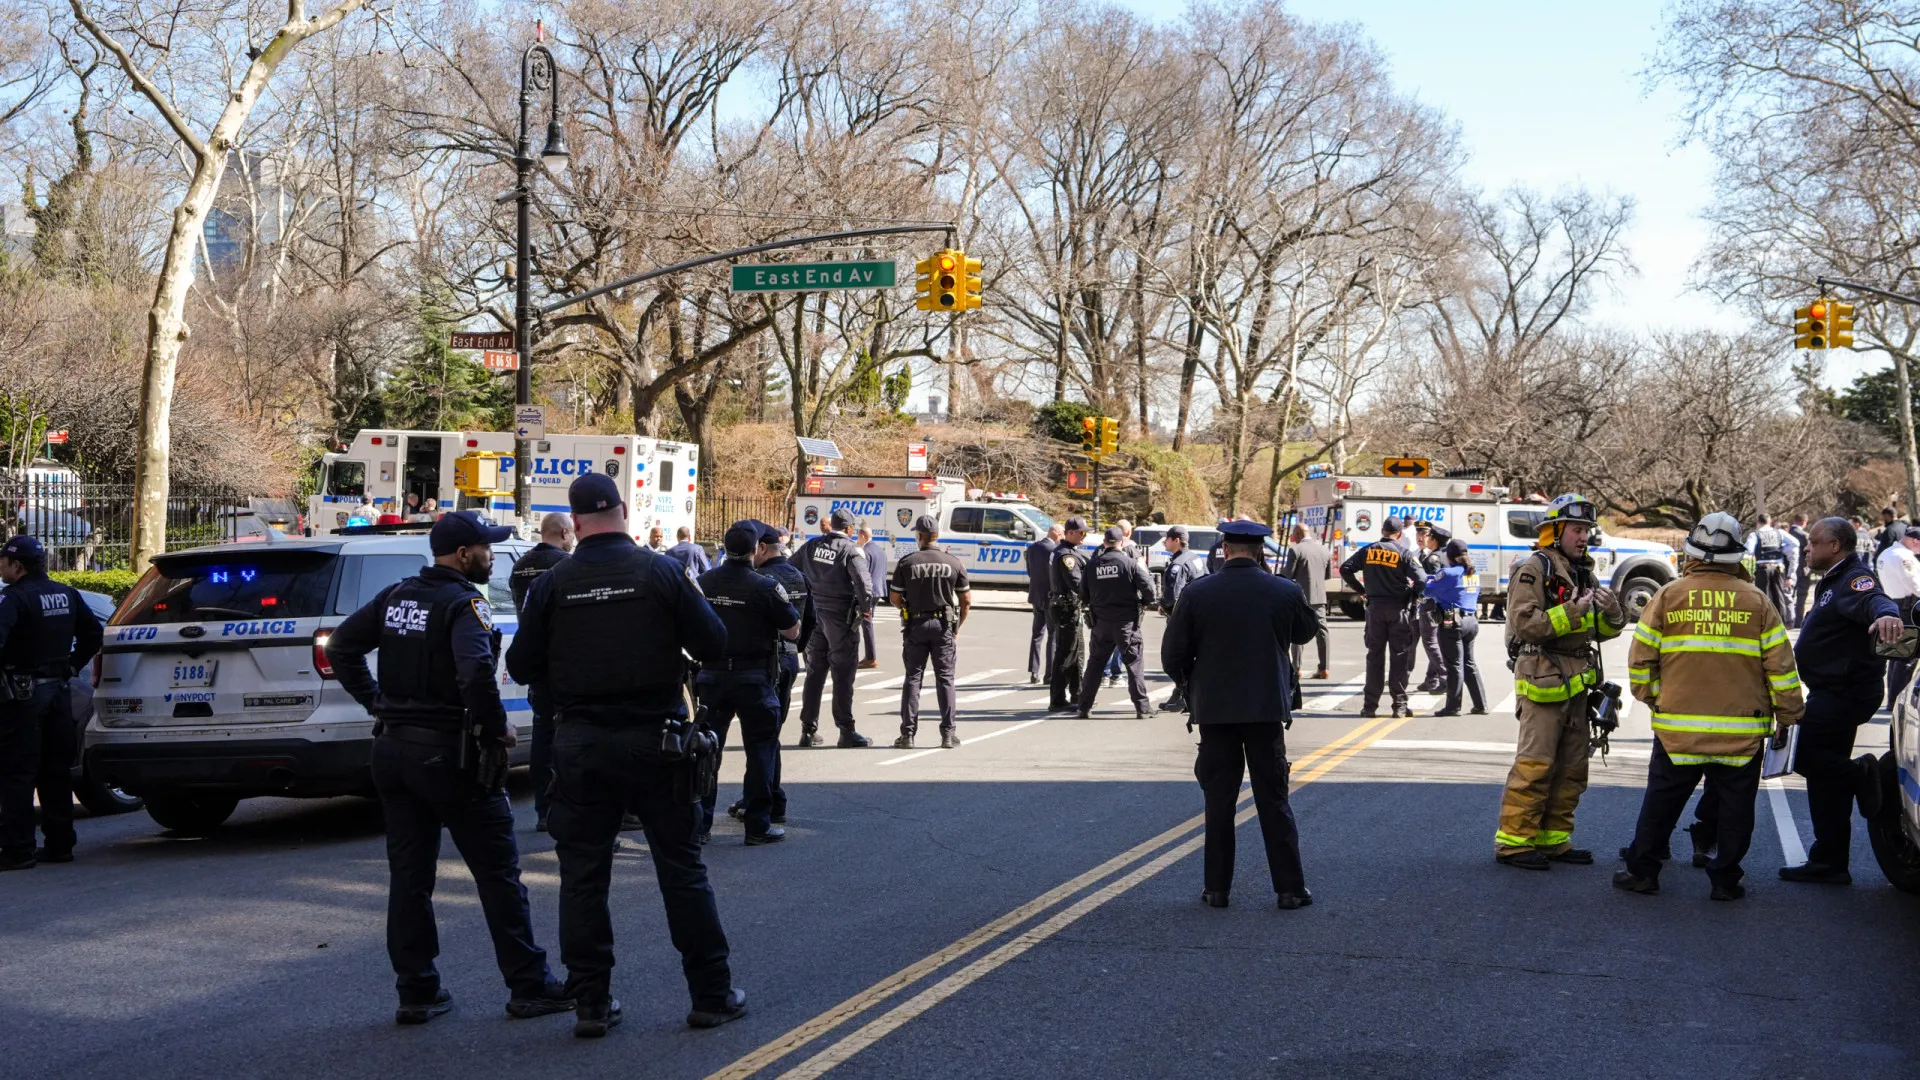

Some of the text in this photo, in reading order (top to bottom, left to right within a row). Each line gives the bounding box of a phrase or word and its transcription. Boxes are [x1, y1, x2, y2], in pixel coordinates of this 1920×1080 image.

[755, 268, 873, 285] East End Av
[452, 336, 509, 348] East End Av
[490, 354, 494, 366] E
[505, 356, 513, 368] St
[499, 457, 593, 475] PLICE
[538, 477, 561, 485] SQUAD
[829, 500, 884, 516] POLICE
[1306, 507, 1324, 517] NYPD
[1389, 505, 1445, 521] POLICE
[814, 547, 836, 560] NYPD
[977, 547, 1021, 564] NYPD
[1366, 548, 1400, 564] NYPD
[911, 563, 951, 580] NYPD
[1096, 565, 1118, 575] NYPD
[40, 593, 69, 609] NYPD
[400, 600, 418, 609] NYPD
[1688, 590, 1737, 608] FDNY
[385, 606, 429, 625] POLICE
[1666, 609, 1752, 624] DIVISION CHIEF
[116, 626, 158, 641] NYPD
[222, 621, 297, 636] POLICE
[385, 621, 426, 632] TRANSIT BUREAU
[1694, 622, 1731, 635] FLYNN
[174, 692, 216, 702] @NYPDCT
[275, 697, 297, 705] CARES
